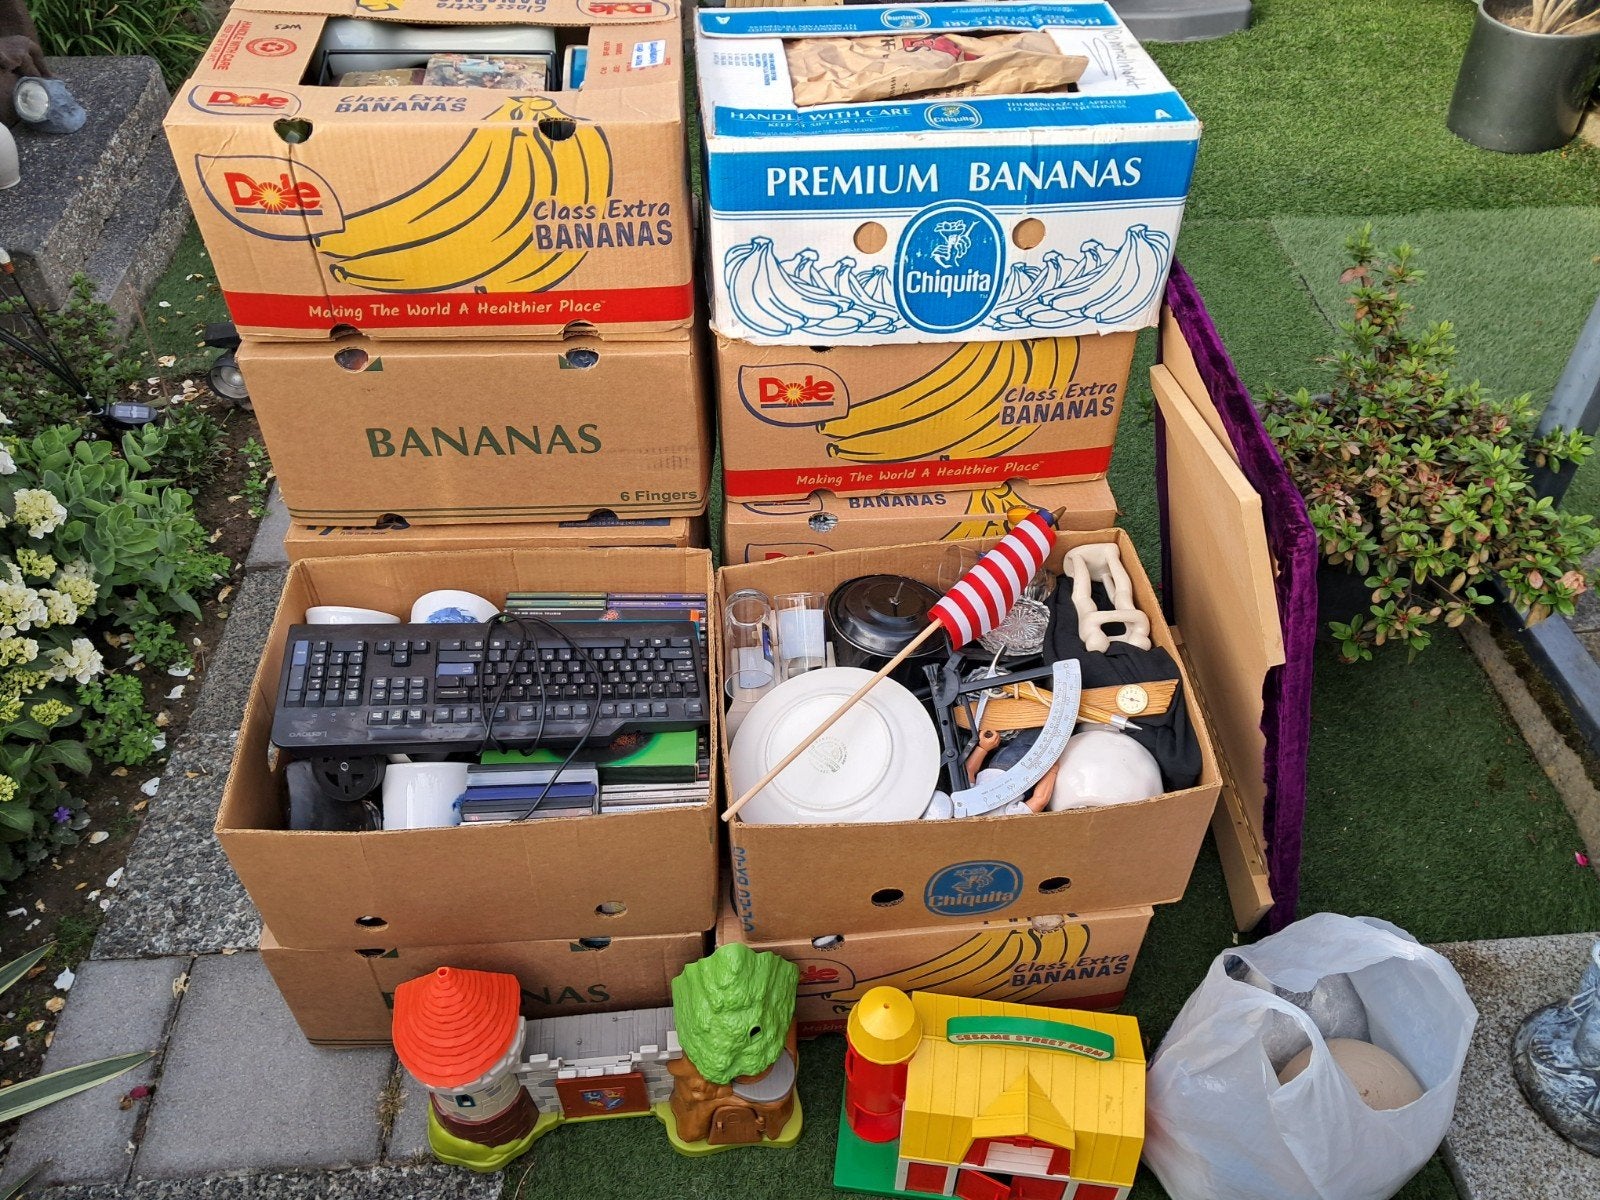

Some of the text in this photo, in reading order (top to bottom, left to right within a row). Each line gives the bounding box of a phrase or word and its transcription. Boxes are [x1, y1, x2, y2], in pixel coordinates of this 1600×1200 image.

[588, 2, 652, 15] Dole
[207, 91, 289, 108] Dole
[335, 102, 466, 113] BANANAS
[340, 93, 467, 103] Class Extra
[730, 107, 912, 121] HANDL WITH CARE
[766, 157, 1142, 197] PREMIUM BANANAS
[224, 172, 321, 212] Dole
[533, 199, 671, 220] Class Extra
[535, 219, 673, 250] BANANAS
[906, 268, 991, 299] Chiquita
[309, 305, 363, 321] Making
[370, 304, 400, 317] The
[407, 303, 451, 316] World
[459, 302, 470, 314] A
[477, 301, 552, 315] Healthier
[759, 375, 835, 406] Dole
[1005, 382, 1118, 403] Class Extra
[1001, 396, 1115, 425] BANANAS
[366, 422, 602, 459] BANANAS
[796, 474, 843, 486] Making
[850, 471, 873, 483] The
[879, 469, 915, 481] World
[921, 468, 931, 478] A
[937, 465, 999, 478] Healthier
[620, 490, 698, 503] 6 Fingers
[849, 493, 946, 509] BANANAS
[929, 890, 1014, 907] Chiquita
[1011, 962, 1128, 987] BANANAS
[1014, 955, 1130, 974] Class Extra
[1016, 1035, 1065, 1047] STREET
[1067, 1043, 1104, 1057] FARM
